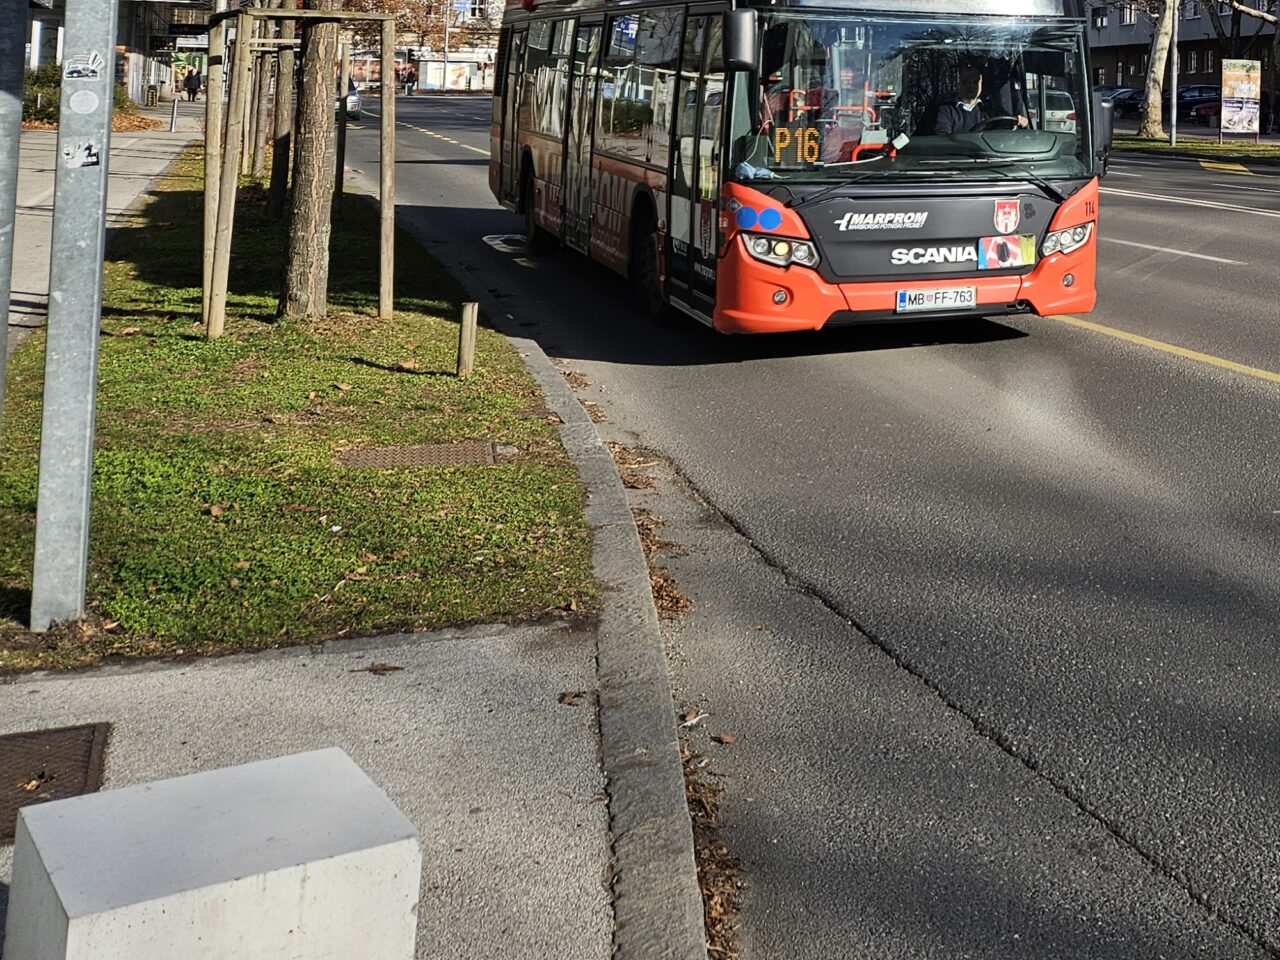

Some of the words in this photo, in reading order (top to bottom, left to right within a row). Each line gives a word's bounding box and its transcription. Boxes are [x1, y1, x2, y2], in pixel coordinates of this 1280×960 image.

[775, 127, 820, 163] P16
[1084, 201, 1095, 216] 114
[850, 212, 928, 225] MARPROM
[891, 246, 978, 265] SCANIA
[908, 293, 924, 305] MB
[934, 291, 973, 304] FF-763
